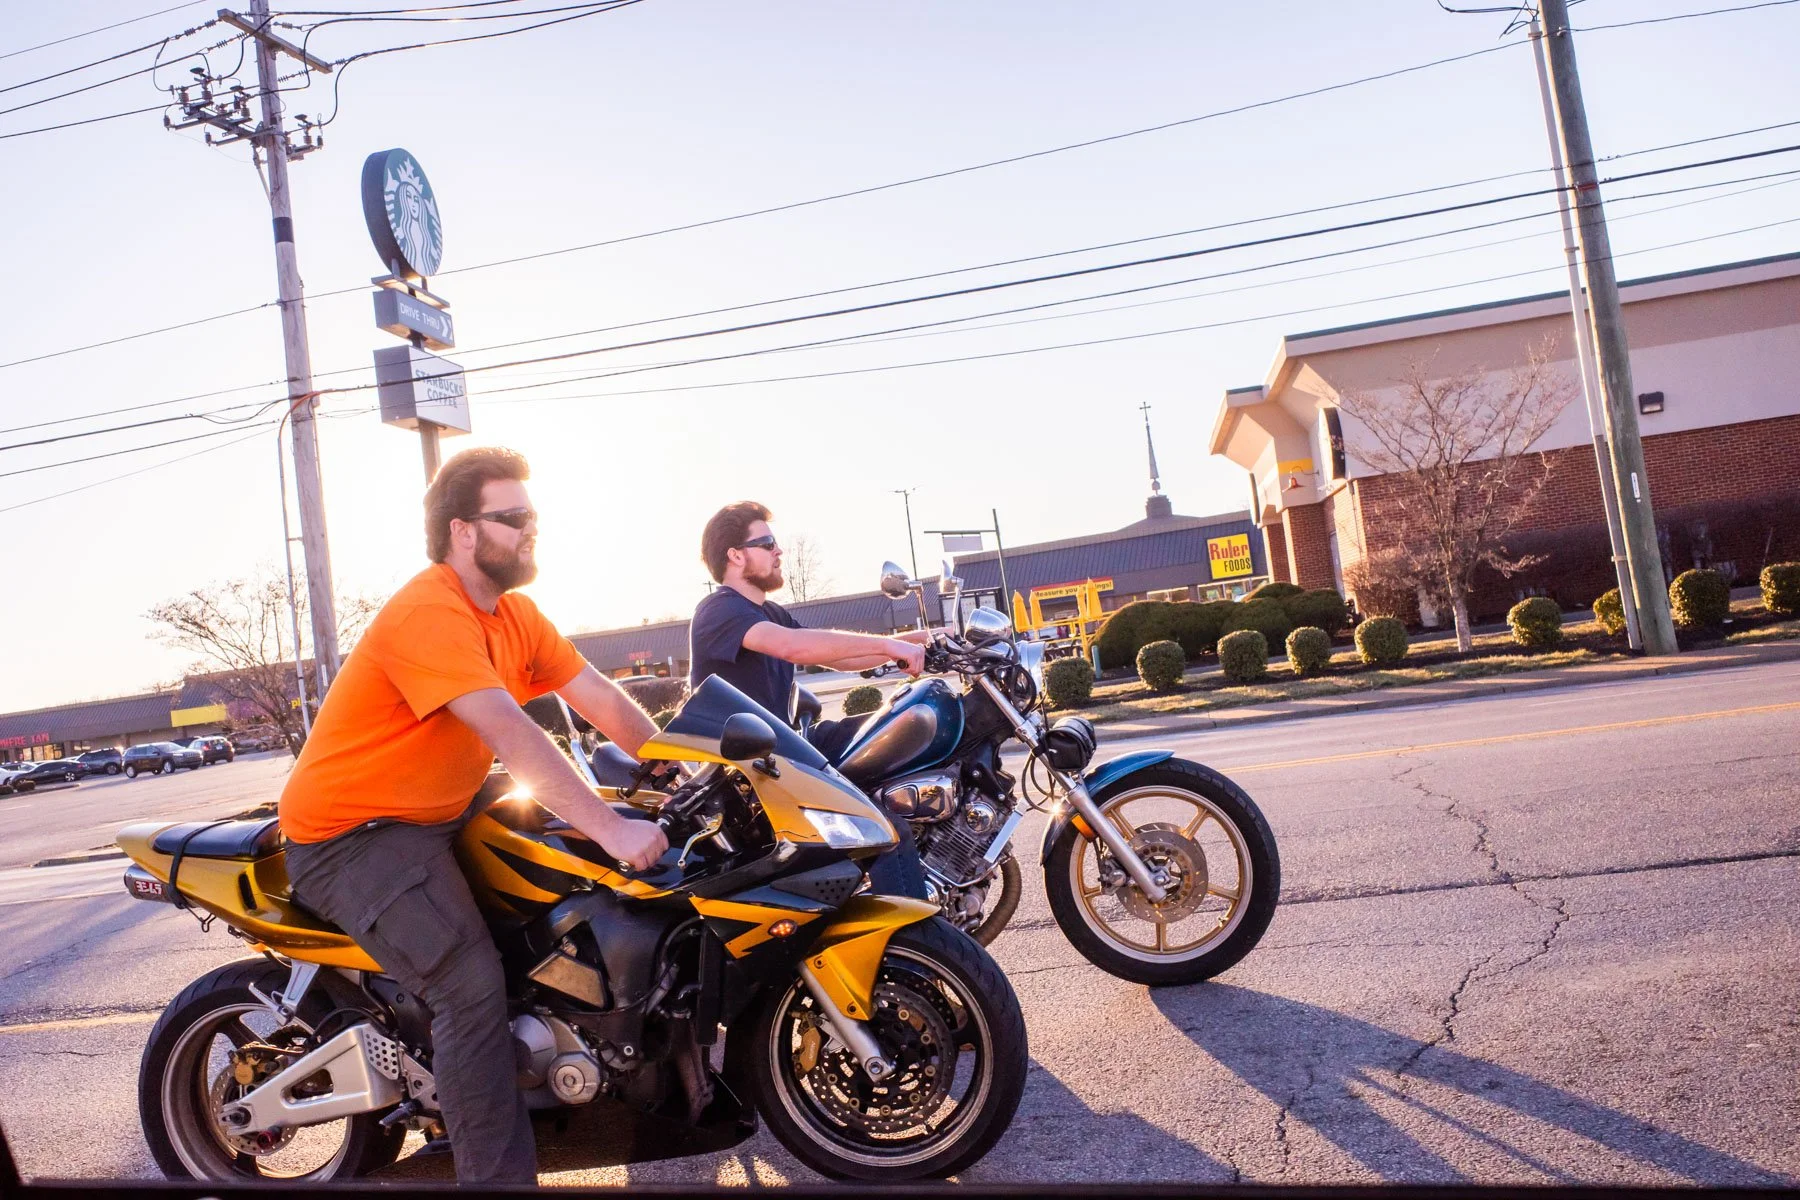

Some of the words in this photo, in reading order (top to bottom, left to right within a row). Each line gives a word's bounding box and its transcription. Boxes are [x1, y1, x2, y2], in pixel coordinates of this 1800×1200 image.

[400, 303, 421, 321] DRIVE
[422, 312, 440, 330] THRU
[415, 369, 464, 396] STARBUCKS
[427, 388, 458, 409] COFFEE
[1209, 539, 1248, 560] Ruler
[1223, 557, 1251, 573] FOODS
